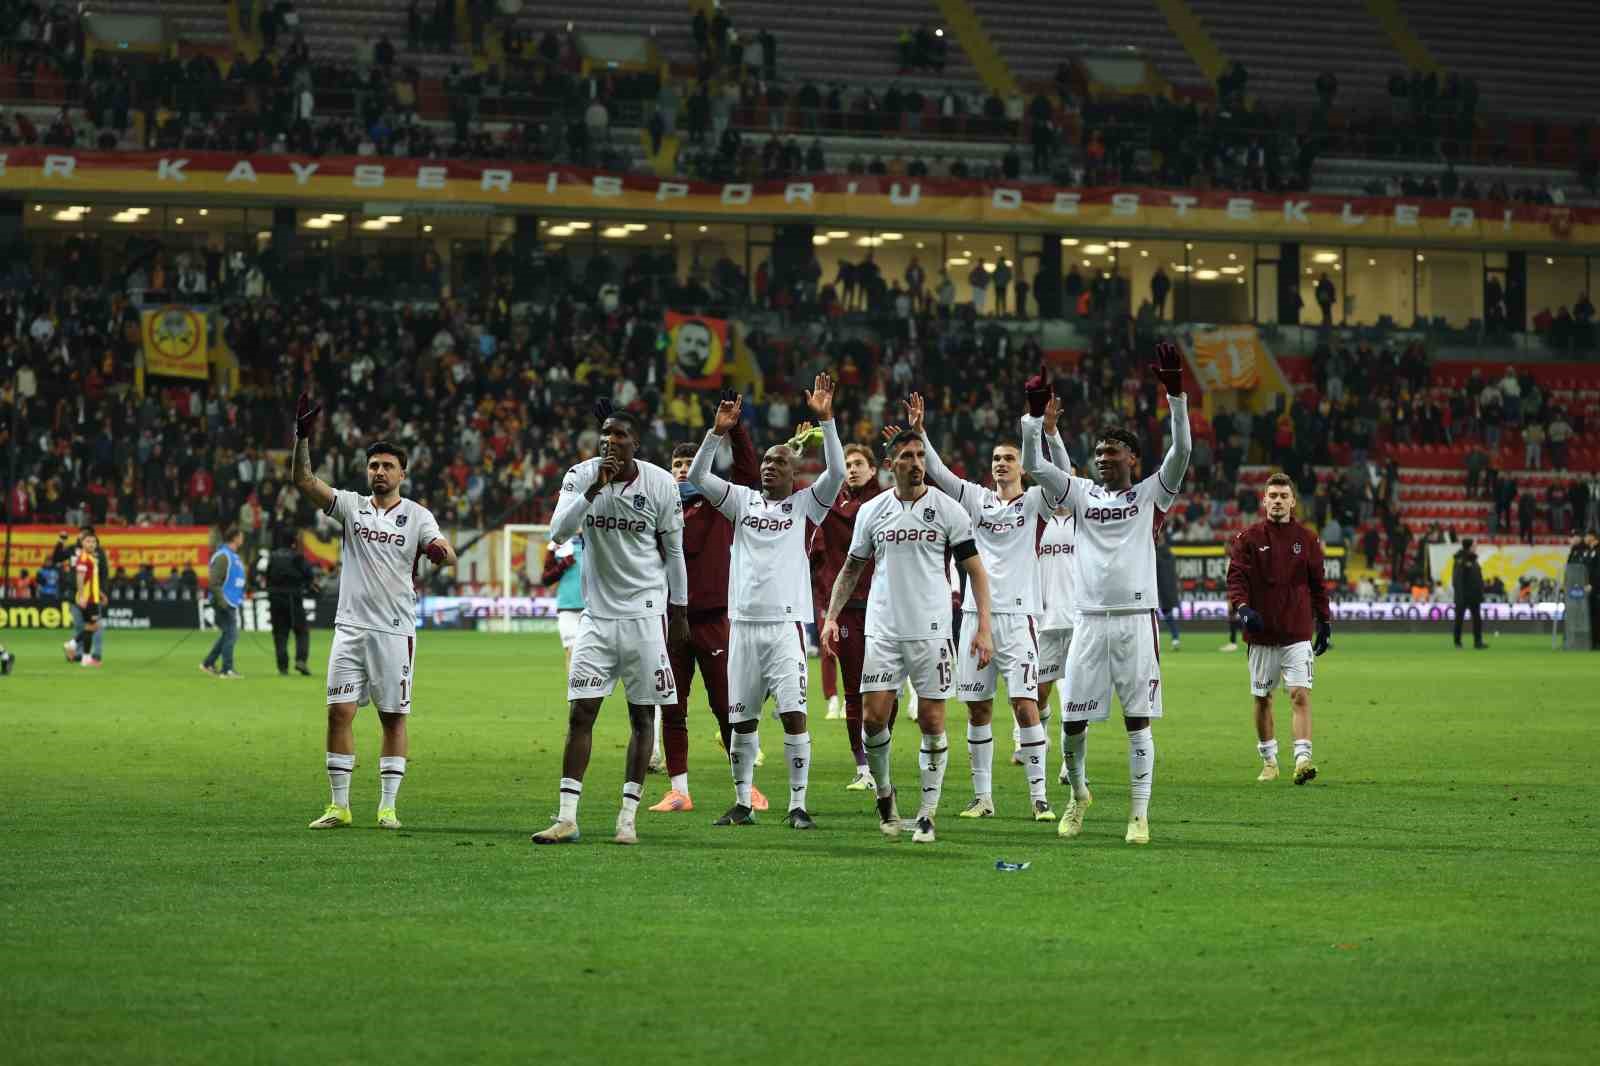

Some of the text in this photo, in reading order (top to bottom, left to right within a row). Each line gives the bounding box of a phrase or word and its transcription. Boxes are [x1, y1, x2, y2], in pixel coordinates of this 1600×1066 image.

[877, 528, 937, 544] papara
[654, 667, 674, 691] 30
[936, 662, 951, 685] 15
